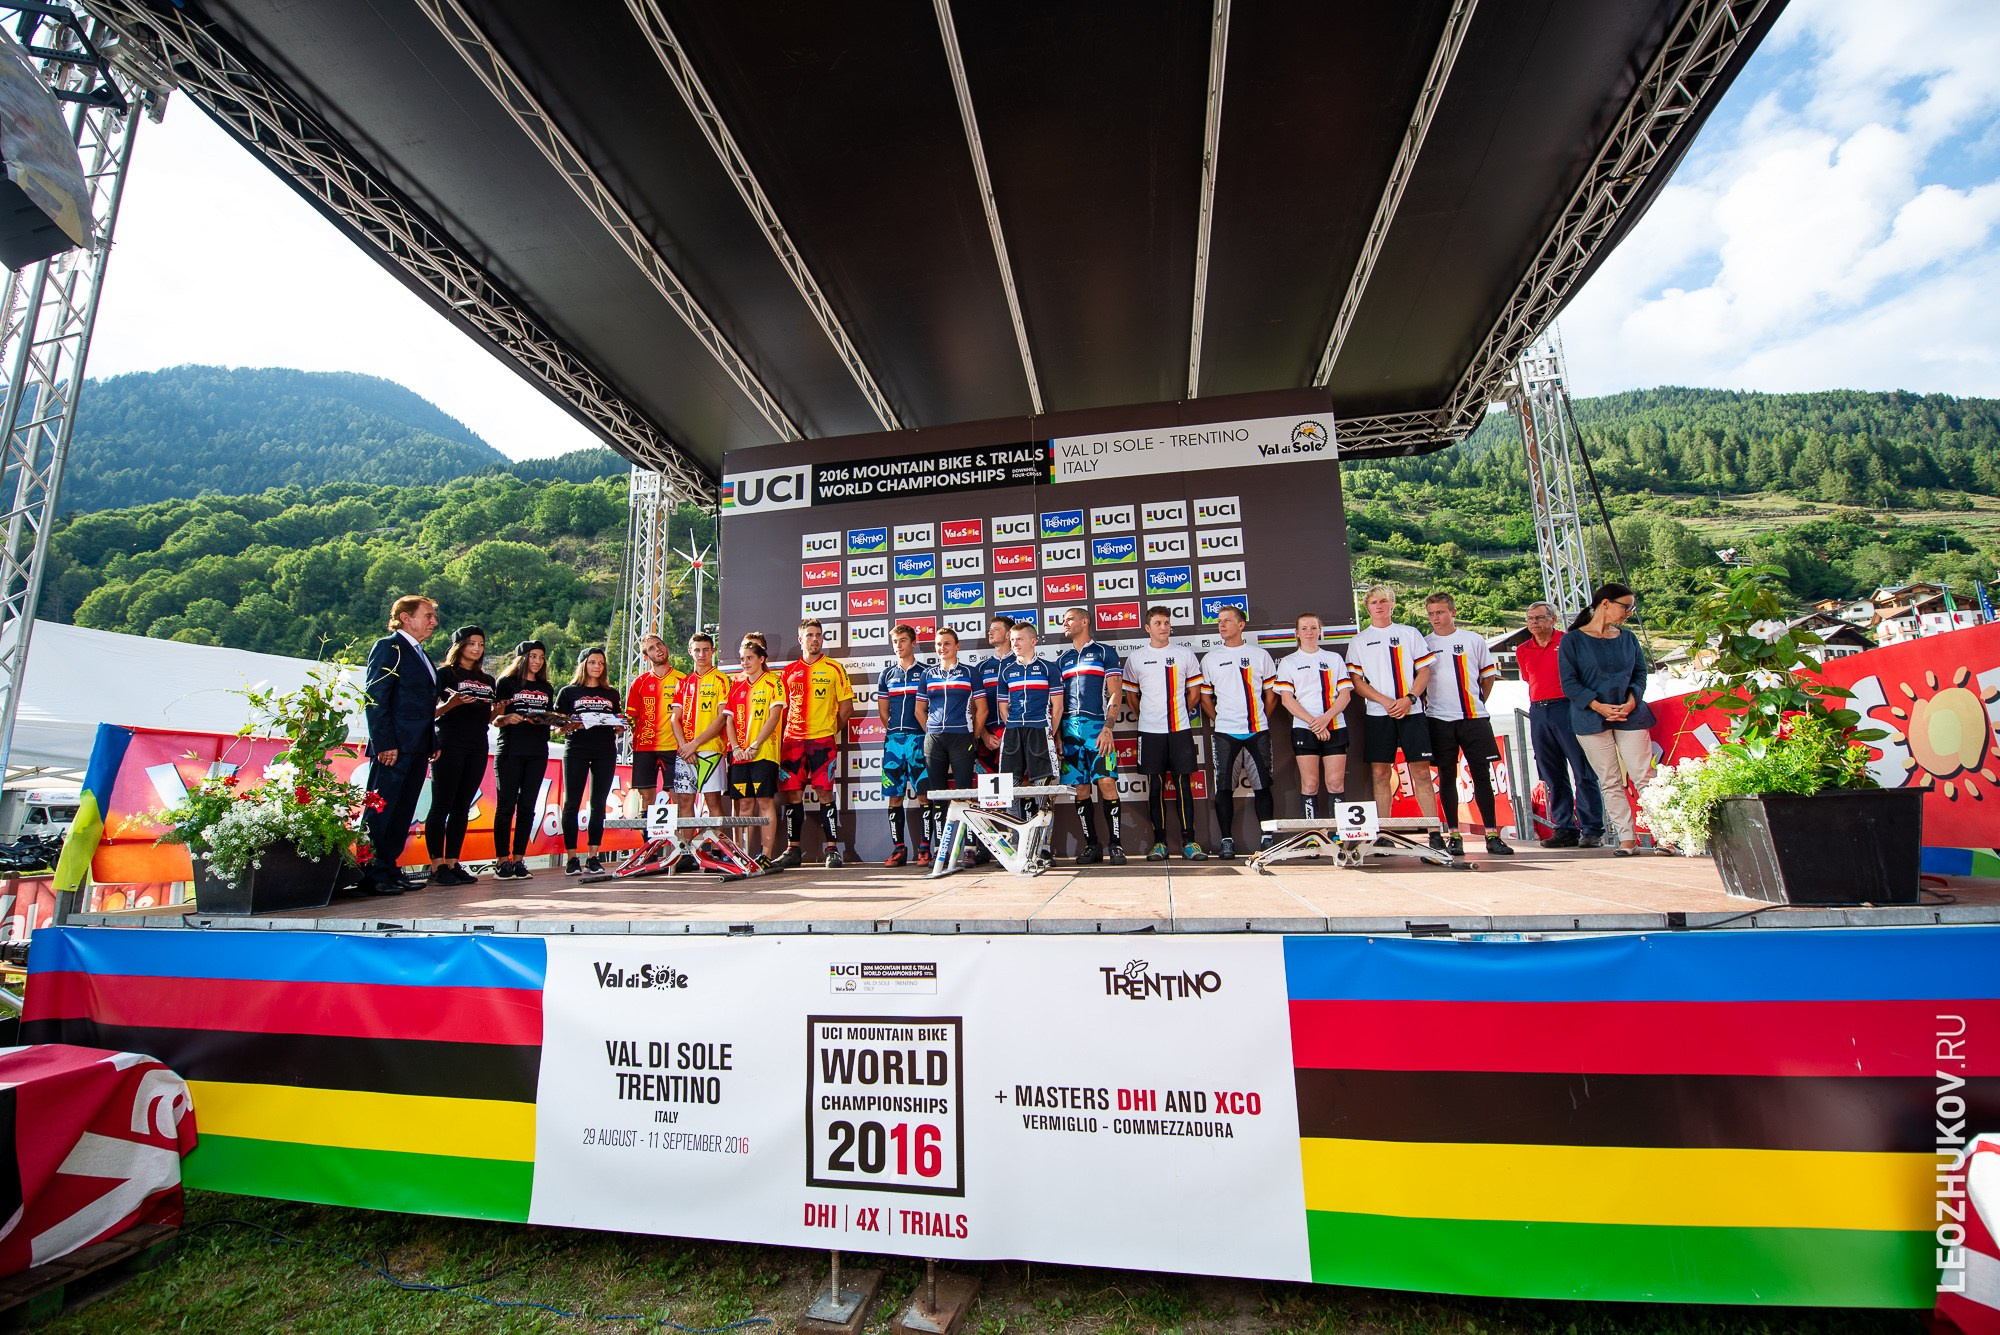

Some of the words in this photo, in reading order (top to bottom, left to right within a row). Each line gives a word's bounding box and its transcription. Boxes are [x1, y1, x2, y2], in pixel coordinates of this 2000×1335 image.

[1061, 441, 1090, 458] VAL
[1093, 441, 1108, 455] DI
[1113, 437, 1154, 453] SOLE
[1169, 428, 1249, 448] TRENTINO
[1257, 443, 1280, 458] Val
[1281, 446, 1291, 454] di
[1293, 441, 1323, 453] Sole
[819, 468, 850, 483] 2016
[853, 459, 935, 479] MOUNTAIN
[939, 455, 972, 471] BIKE
[976, 454, 987, 467] &
[989, 448, 1045, 465] TRIALS
[1063, 459, 1099, 475] ITALY
[737, 473, 804, 506] UCI
[819, 482, 873, 498] WORLD
[876, 468, 1006, 492] CHAMPIONSHIPS
[1153, 508, 1182, 521] UCI
[1205, 504, 1236, 517] UCI
[1044, 517, 1080, 528] TRENTINO
[1101, 512, 1130, 524] UCI
[1003, 522, 1030, 534] UCI
[851, 534, 884, 545] TRENTINO
[904, 530, 930, 542] UCI
[1208, 536, 1239, 549] UCI
[812, 539, 837, 550] UCI
[1096, 543, 1132, 555] TRENTINO
[1155, 540, 1185, 552] UCI
[996, 555, 1009, 565] Val
[1052, 548, 1081, 561] UCI
[898, 560, 932, 572] TRENTINO
[952, 557, 980, 569] UCI
[858, 564, 884, 576] UCI
[1210, 570, 1241, 582] UCI
[1106, 577, 1134, 590] UCI
[1150, 573, 1187, 584] TRENTINO
[946, 589, 981, 600] TRENTINO
[1004, 586, 1033, 598] UCI
[1046, 583, 1059, 593] Val
[905, 593, 932, 605] UCI
[812, 600, 836, 612] UCI
[1099, 612, 1112, 622] Val
[954, 620, 981, 632] UCI
[858, 627, 884, 639] UCI
[859, 692, 878, 702] UC
[1115, 712, 1137, 723] UC
[990, 776, 1000, 794] 1
[1117, 781, 1146, 794] UCI
[656, 807, 668, 824] 2
[1348, 805, 1366, 826] 3
[593, 962, 624, 989] Val
[626, 973, 640, 988] di
[640, 964, 689, 990] Sole
[836, 966, 859, 976] UCI
[1099, 966, 1222, 1000] TRENTINO
[821, 1026, 843, 1040] UCI
[847, 1027, 914, 1042] MOUNTAIN
[918, 1028, 948, 1042] BIKE
[606, 1040, 642, 1068] VAL
[649, 1042, 670, 1068] DI
[677, 1042, 732, 1071] SOLE
[820, 1048, 948, 1086] WORLD
[616, 1072, 721, 1105] TRENTINO
[821, 1095, 948, 1114] CHAMPIONSHIPS
[1015, 1085, 1110, 1111] MASTERS
[1117, 1088, 1157, 1112] DHI
[1165, 1090, 1208, 1114] AND
[1214, 1092, 1262, 1116] XCO
[654, 1110, 679, 1124] ITALY
[1022, 1114, 1098, 1133] VERMIGLIO
[1113, 1118, 1234, 1139] COMMEZZADURA
[582, 1128, 596, 1145] 29
[598, 1128, 638, 1148] AUGUST
[648, 1132, 659, 1149] 11
[662, 1132, 722, 1153] SEPTEMBER
[724, 1136, 749, 1155] 2016
[828, 1120, 942, 1178] 2016
[804, 1203, 837, 1229] DHI
[856, 1208, 880, 1232] 4X
[899, 1210, 968, 1239] TRIALS
